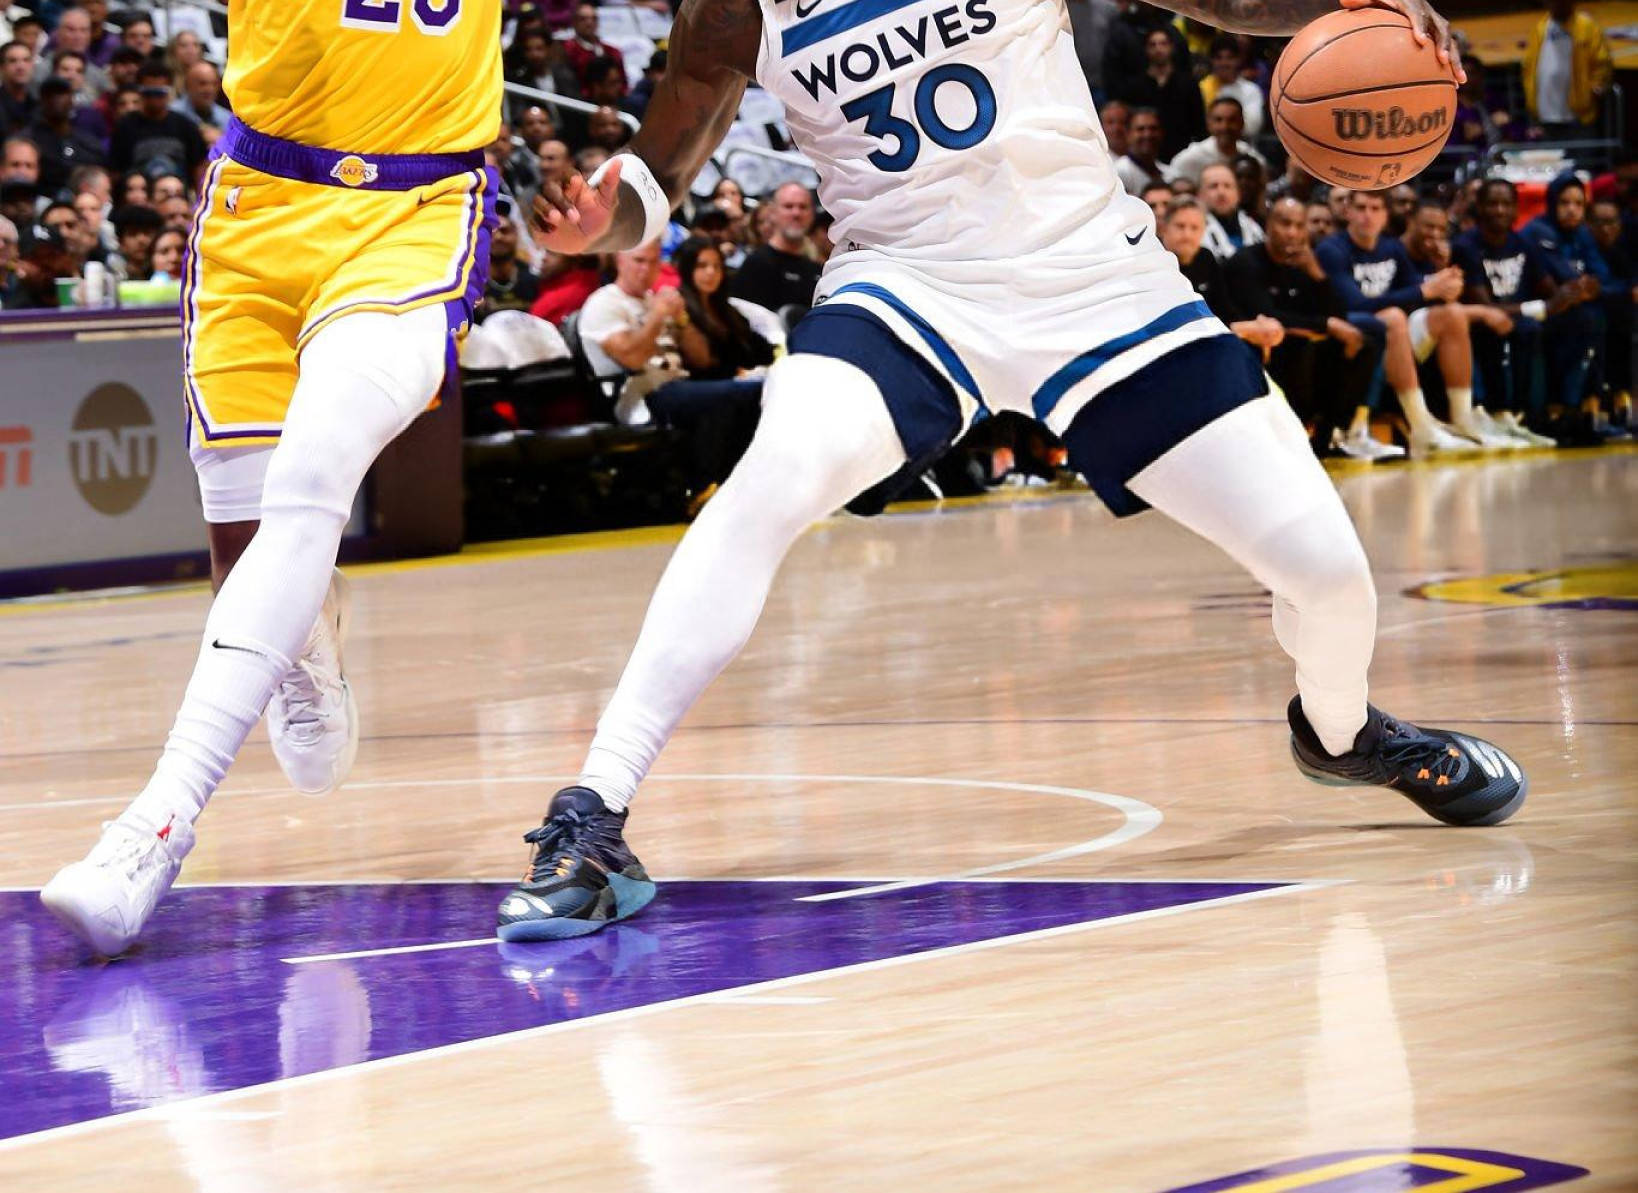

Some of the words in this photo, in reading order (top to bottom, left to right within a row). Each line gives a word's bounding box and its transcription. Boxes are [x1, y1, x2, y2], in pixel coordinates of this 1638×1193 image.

[839, 62, 998, 173] 30
[1331, 105, 1447, 141] Wilson
[69, 424, 157, 483] TNT
